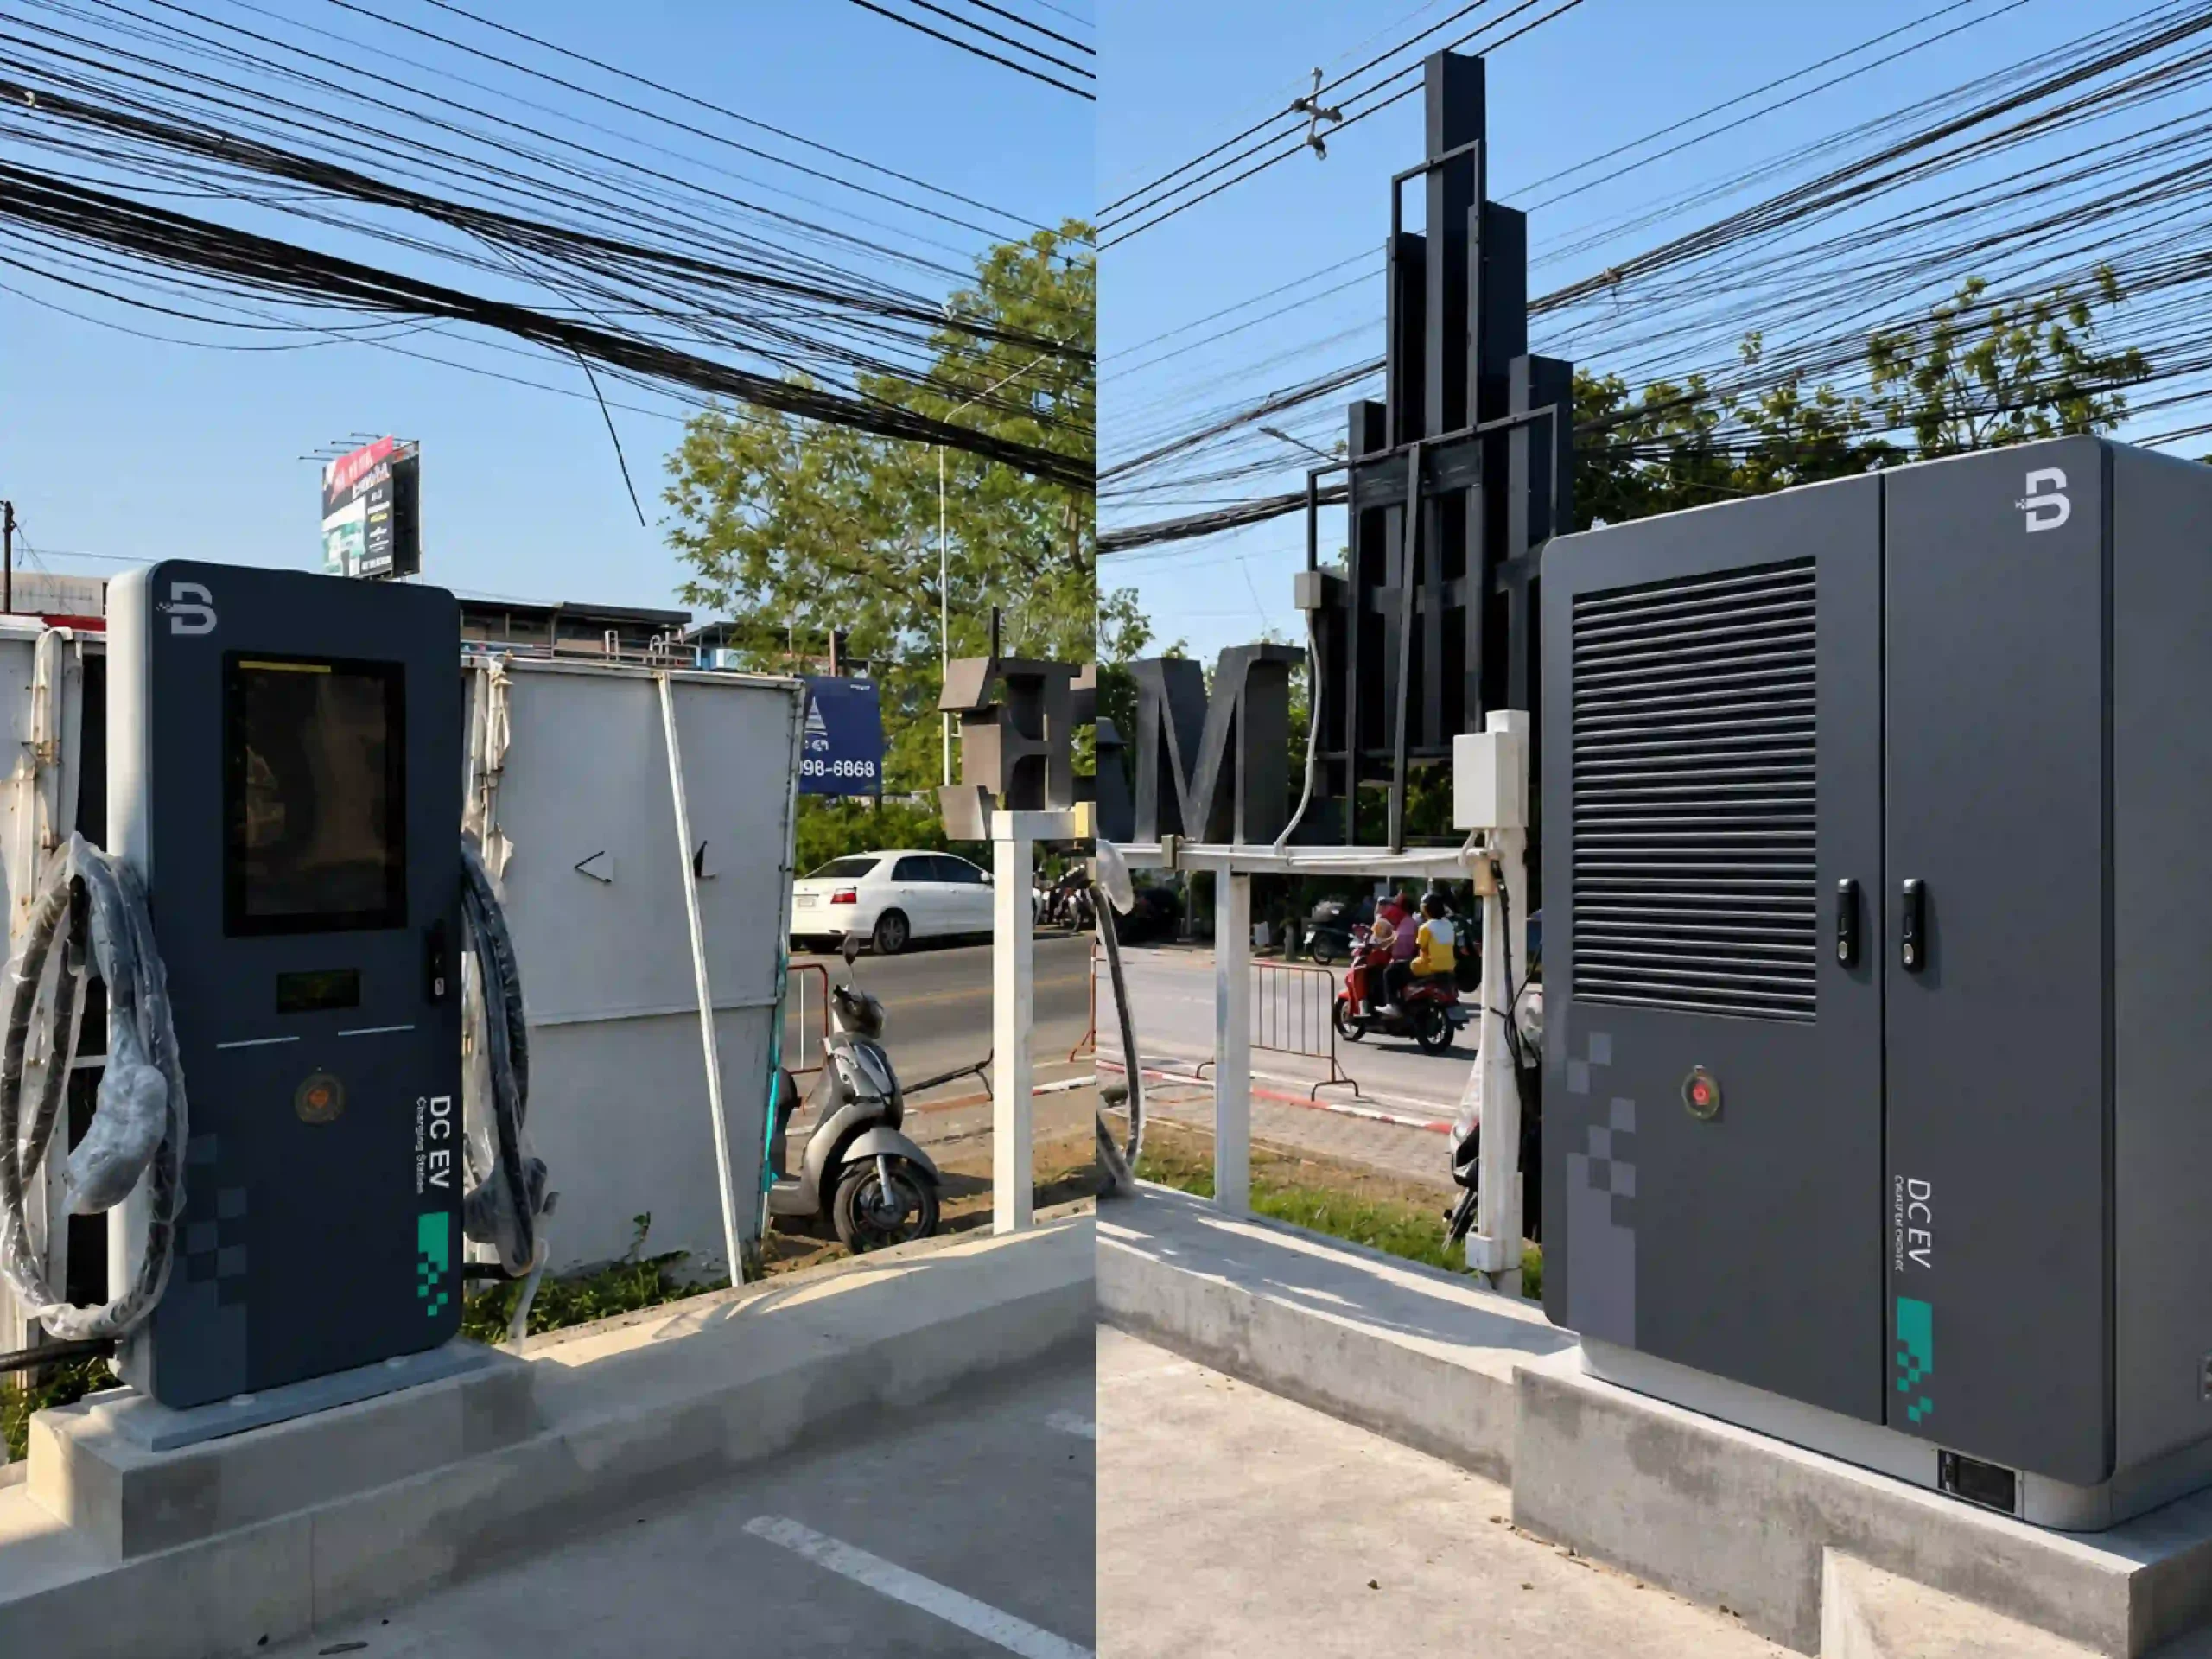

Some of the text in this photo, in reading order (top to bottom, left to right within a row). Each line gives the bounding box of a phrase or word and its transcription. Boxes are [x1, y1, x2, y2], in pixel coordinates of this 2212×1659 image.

[799, 760, 875, 777] 98-6868
[429, 1095, 451, 1189] DC EV
[1908, 1178, 1931, 1269] DC EV
